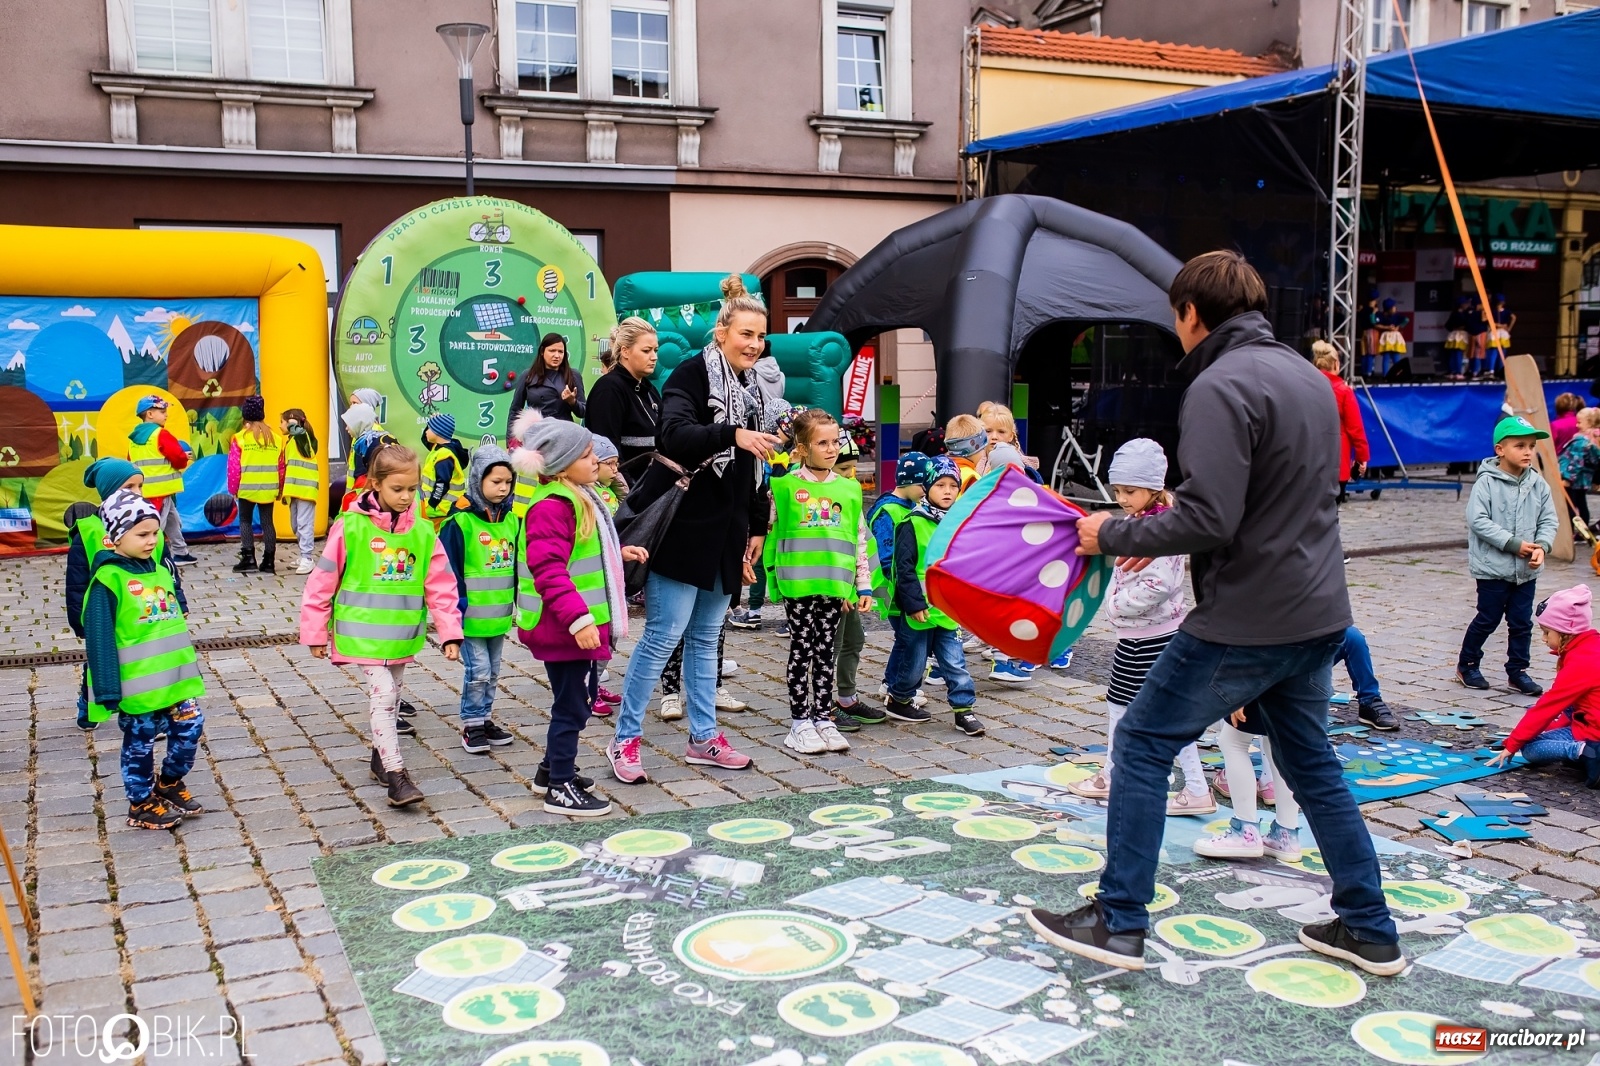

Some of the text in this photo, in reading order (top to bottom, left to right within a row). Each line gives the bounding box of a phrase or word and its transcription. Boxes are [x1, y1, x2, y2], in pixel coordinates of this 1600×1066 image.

[387, 215, 416, 241] DBAJ
[419, 211, 427, 219] O
[431, 198, 473, 215] CZYSTE
[475, 198, 535, 216] POWIETRZE
[480, 245, 503, 254] ROWER
[381, 256, 393, 285] 1
[485, 260, 501, 288] 3
[585, 271, 595, 300] 1
[417, 296, 456, 305] LOKALNYCH
[408, 324, 427, 355] 3
[449, 341, 534, 354] PANELE FOTOWOLTAICZNE
[341, 364, 387, 374] ELEKTRYCZNE
[355, 353, 373, 361] AUTO
[482, 357, 499, 385] 5
[847, 354, 873, 412] WYNAJMĘ
[477, 400, 495, 429] 3
[796, 492, 809, 500] STOP
[371, 541, 386, 549] STOP
[128, 583, 144, 592] STOP
[706, 745, 721, 758] N
[781, 924, 827, 953] meta
[622, 911, 747, 1017] EKO BOHATER
